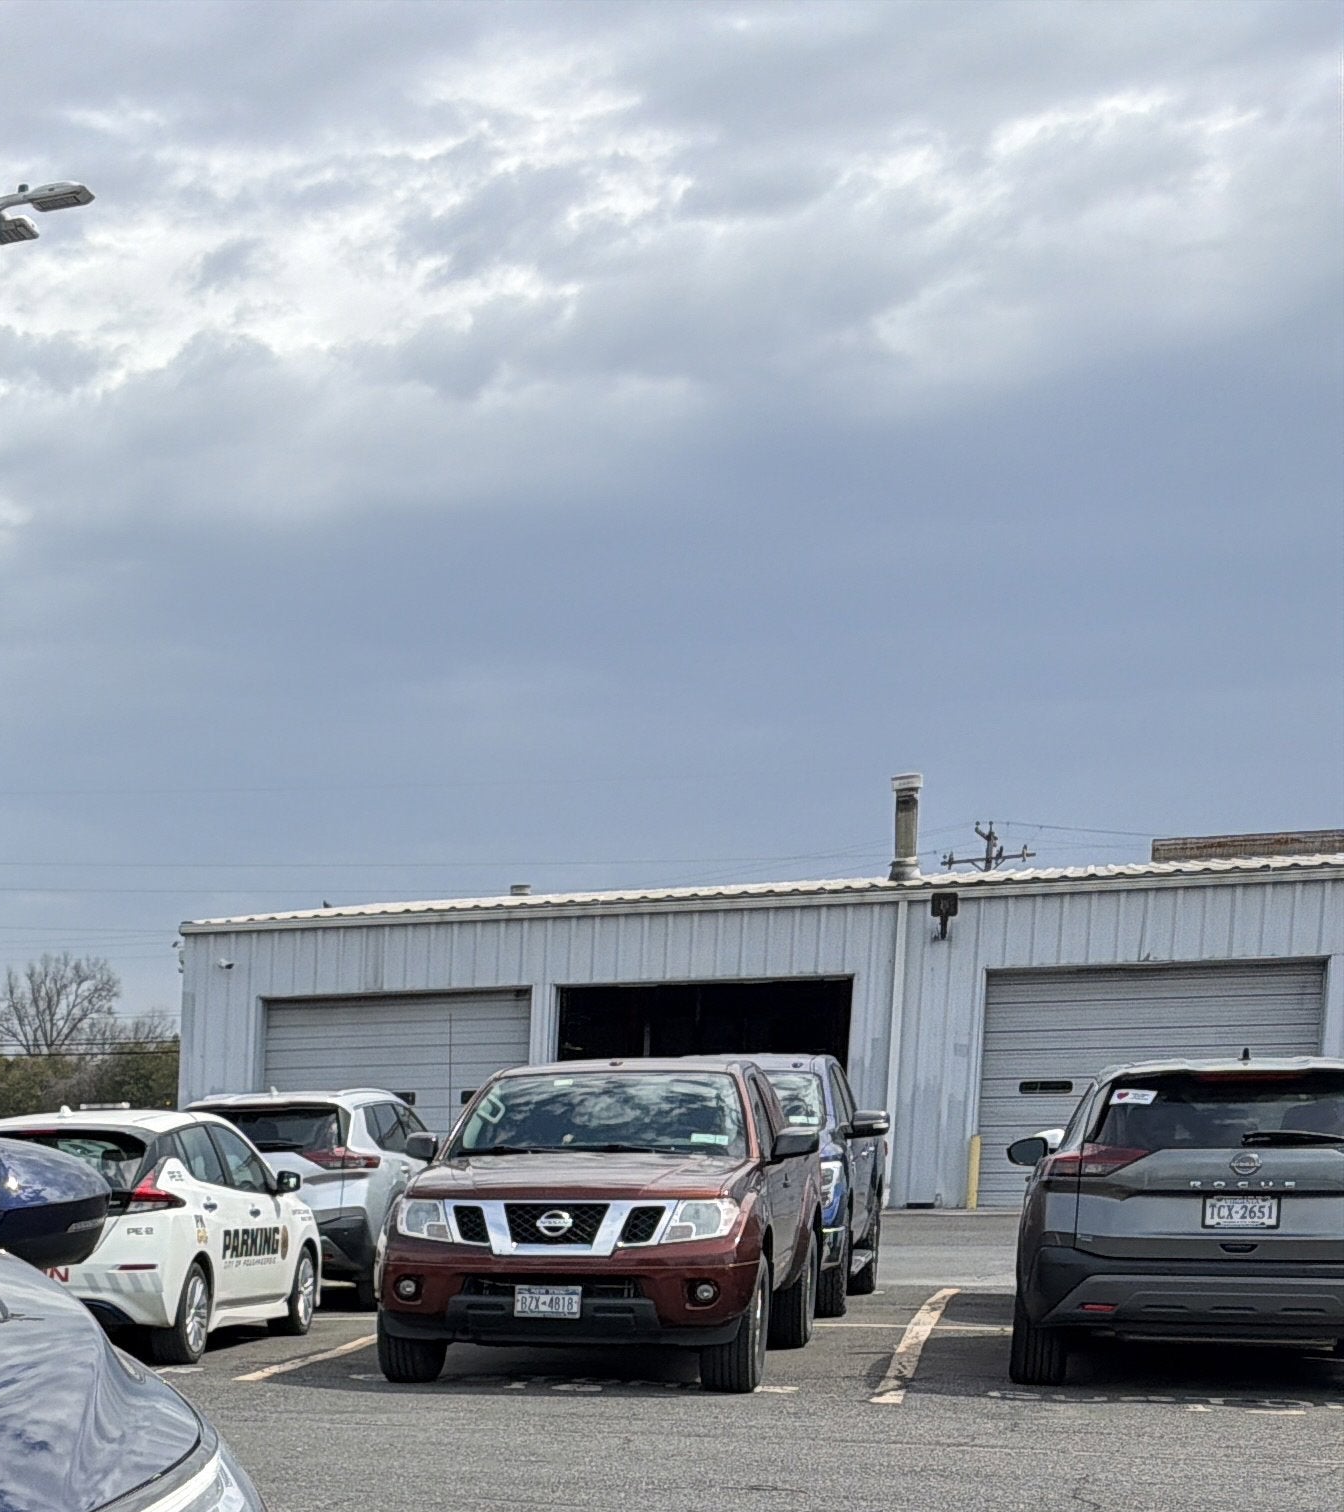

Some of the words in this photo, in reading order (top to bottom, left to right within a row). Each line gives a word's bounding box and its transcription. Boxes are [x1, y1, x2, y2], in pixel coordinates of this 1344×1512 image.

[1189, 1181, 1296, 1189] ROGUE
[1208, 1203, 1273, 1220] TCX-2651
[222, 1226, 280, 1260] PARKING
